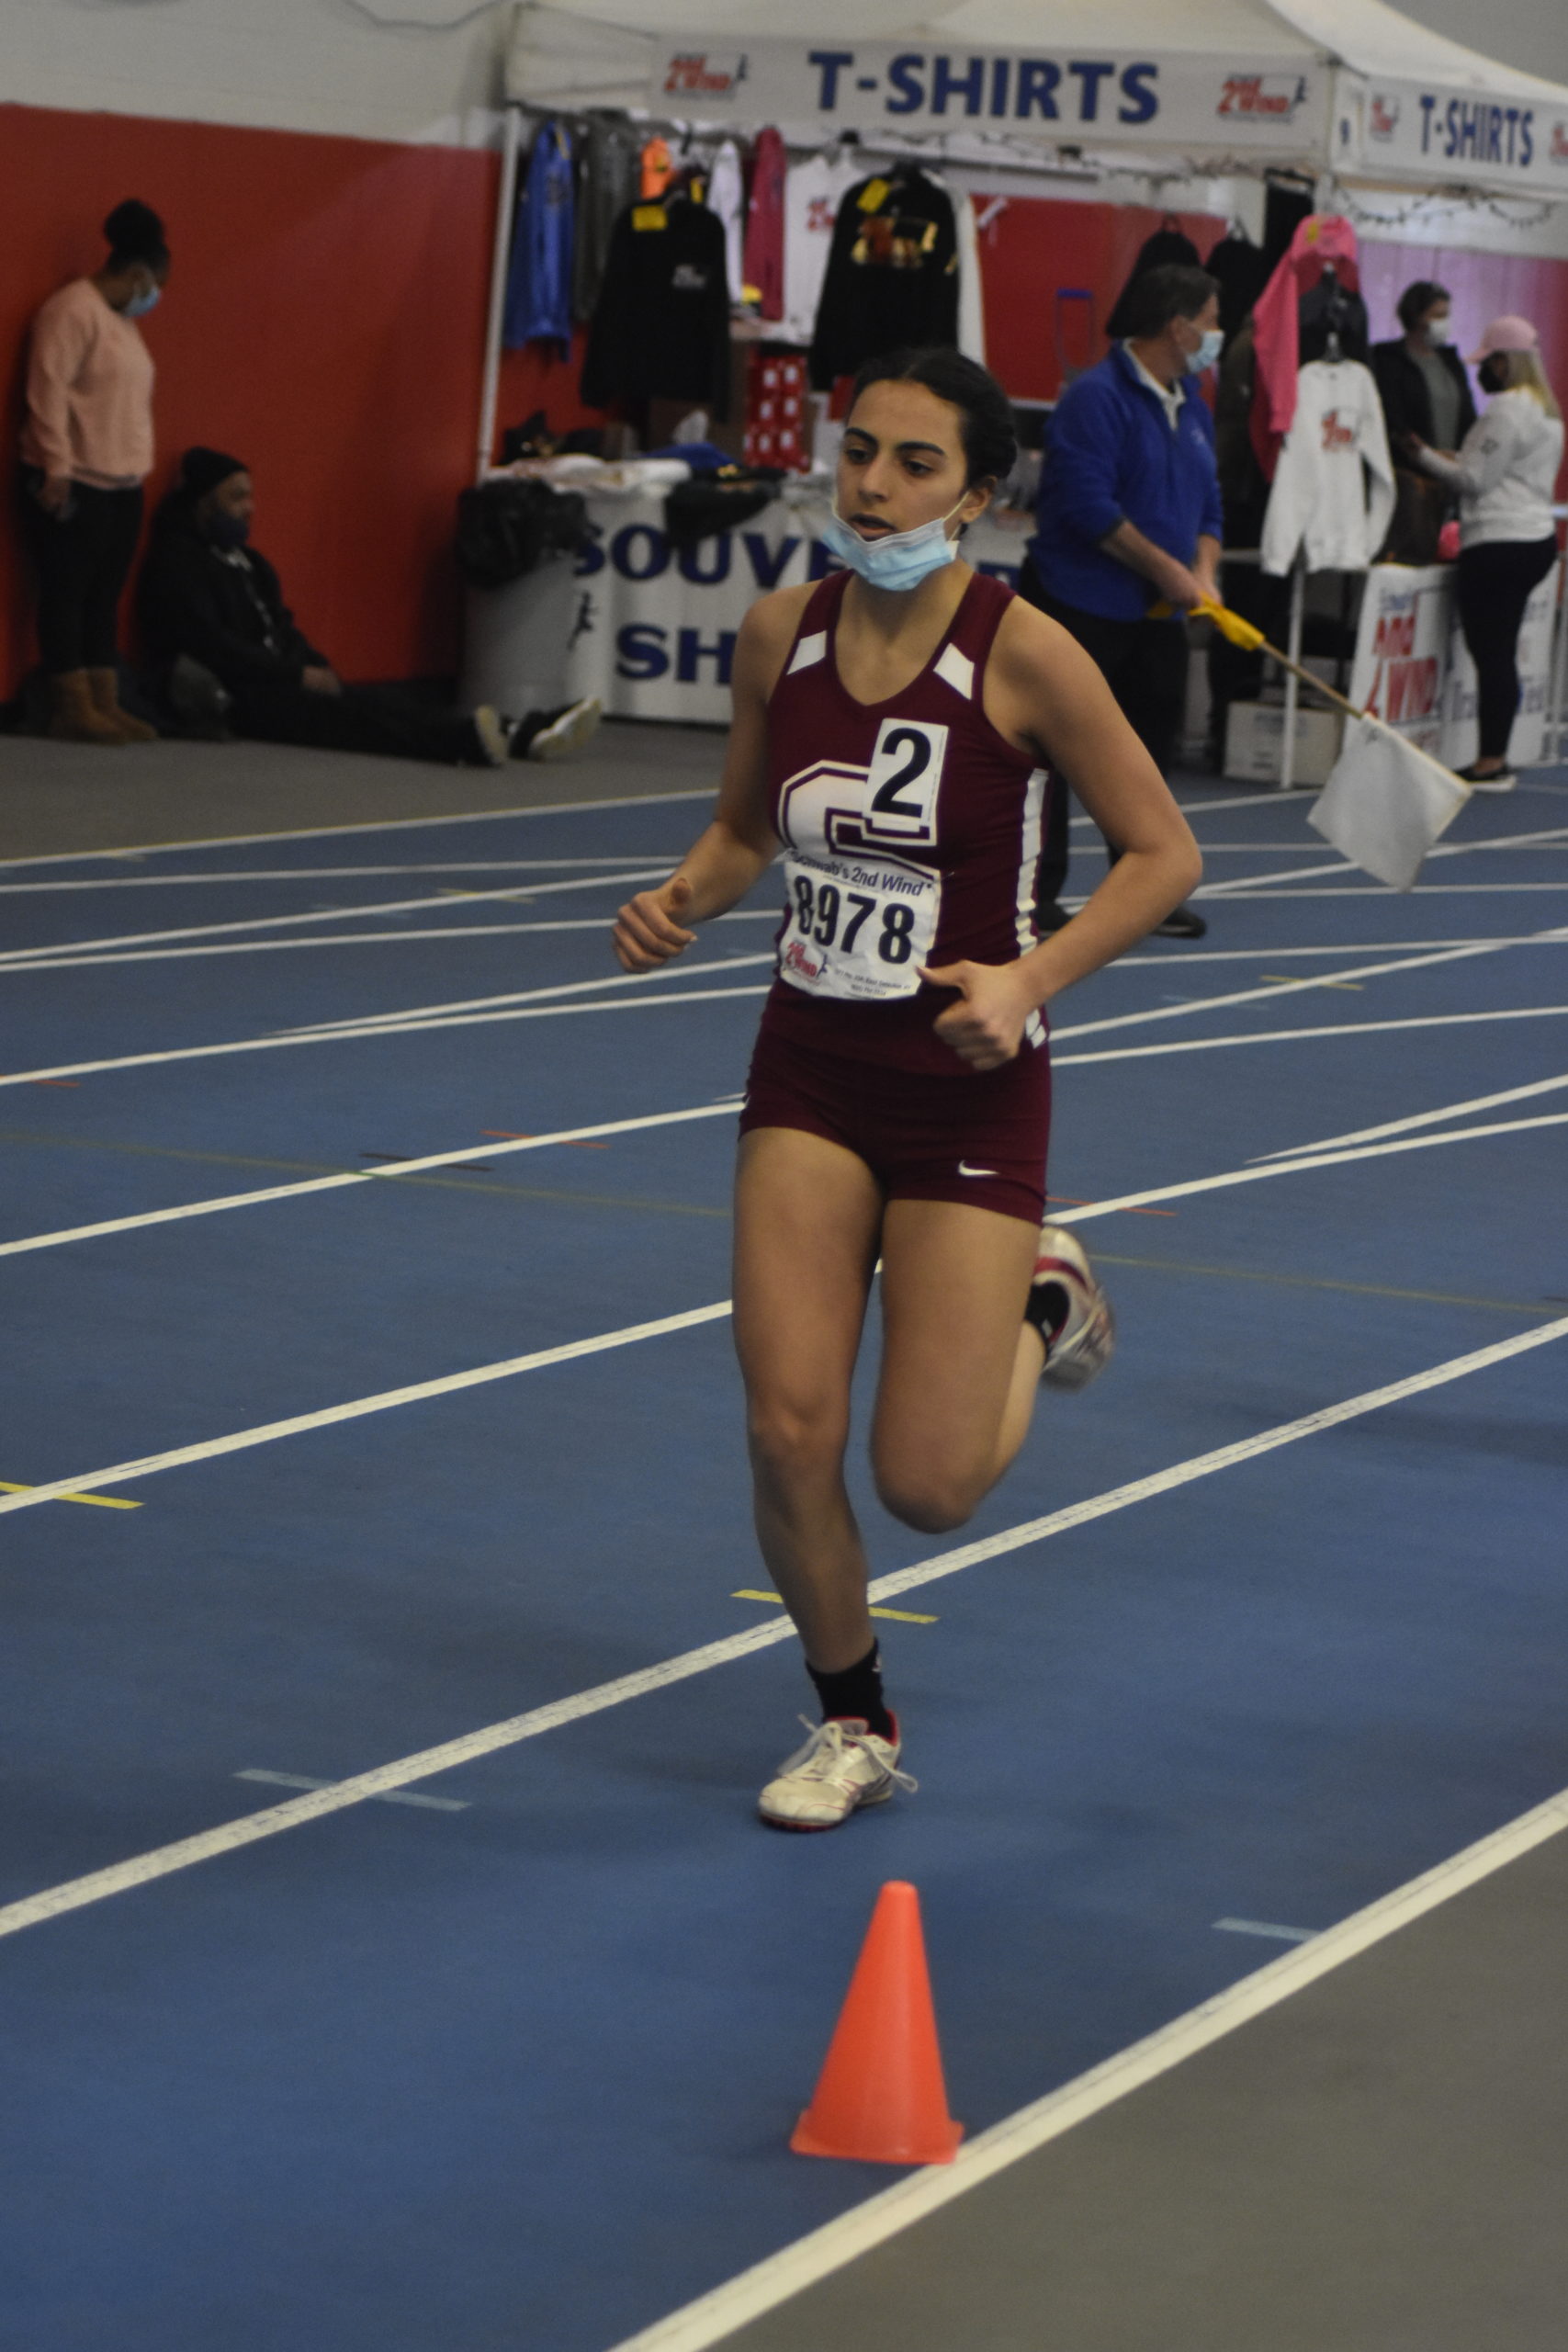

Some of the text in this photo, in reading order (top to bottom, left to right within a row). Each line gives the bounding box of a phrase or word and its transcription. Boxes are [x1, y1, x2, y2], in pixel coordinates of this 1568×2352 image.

[808, 51, 1159, 123] T-SHIRTS
[1419, 94, 1534, 167] T-SHIRTS
[872, 727, 931, 818] 2
[851, 866, 880, 888] 2nd
[795, 875, 915, 965] 8978
